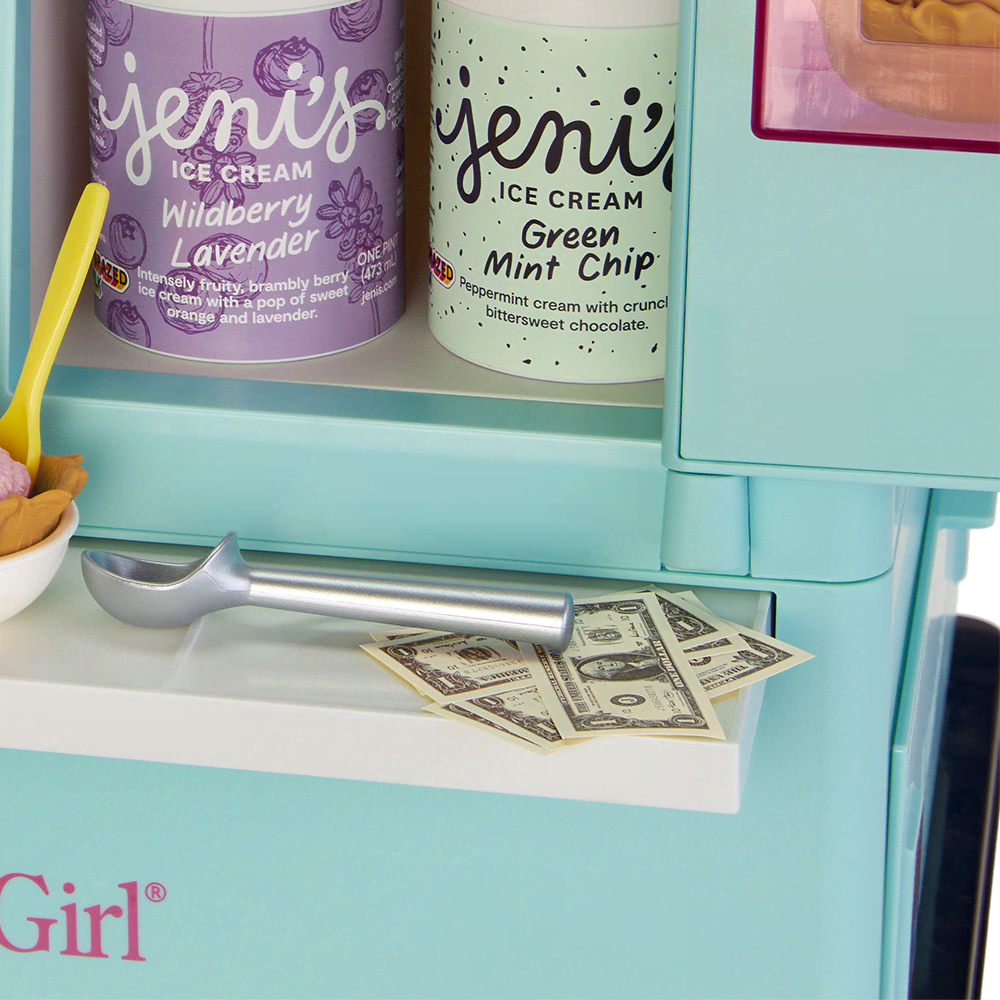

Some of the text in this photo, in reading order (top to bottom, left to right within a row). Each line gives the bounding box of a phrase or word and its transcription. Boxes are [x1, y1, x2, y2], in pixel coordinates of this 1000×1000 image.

[98, 51, 386, 186] jeni's
[172, 160, 312, 184] ICE CREAM
[162, 193, 312, 229] Wildberry
[500, 182, 642, 210] ICE CREAM
[170, 228, 320, 268] Lavender
[522, 219, 620, 250] Green
[358, 246, 381, 266] ONE
[484, 250, 560, 280] Mint
[578, 247, 655, 281] Chip
[138, 266, 349, 296] Intensely fruity, brambly berry
[361, 262, 384, 284] (473
[138, 284, 349, 310] ice cream with pop of sweet
[361, 275, 397, 305] jenis.com
[460, 276, 529, 307] Peppermint
[533, 298, 580, 313] cream
[586, 300, 618, 313] with
[167, 306, 318, 326] orange and lavender.
[486, 305, 649, 332] bittersweet chocolate.
